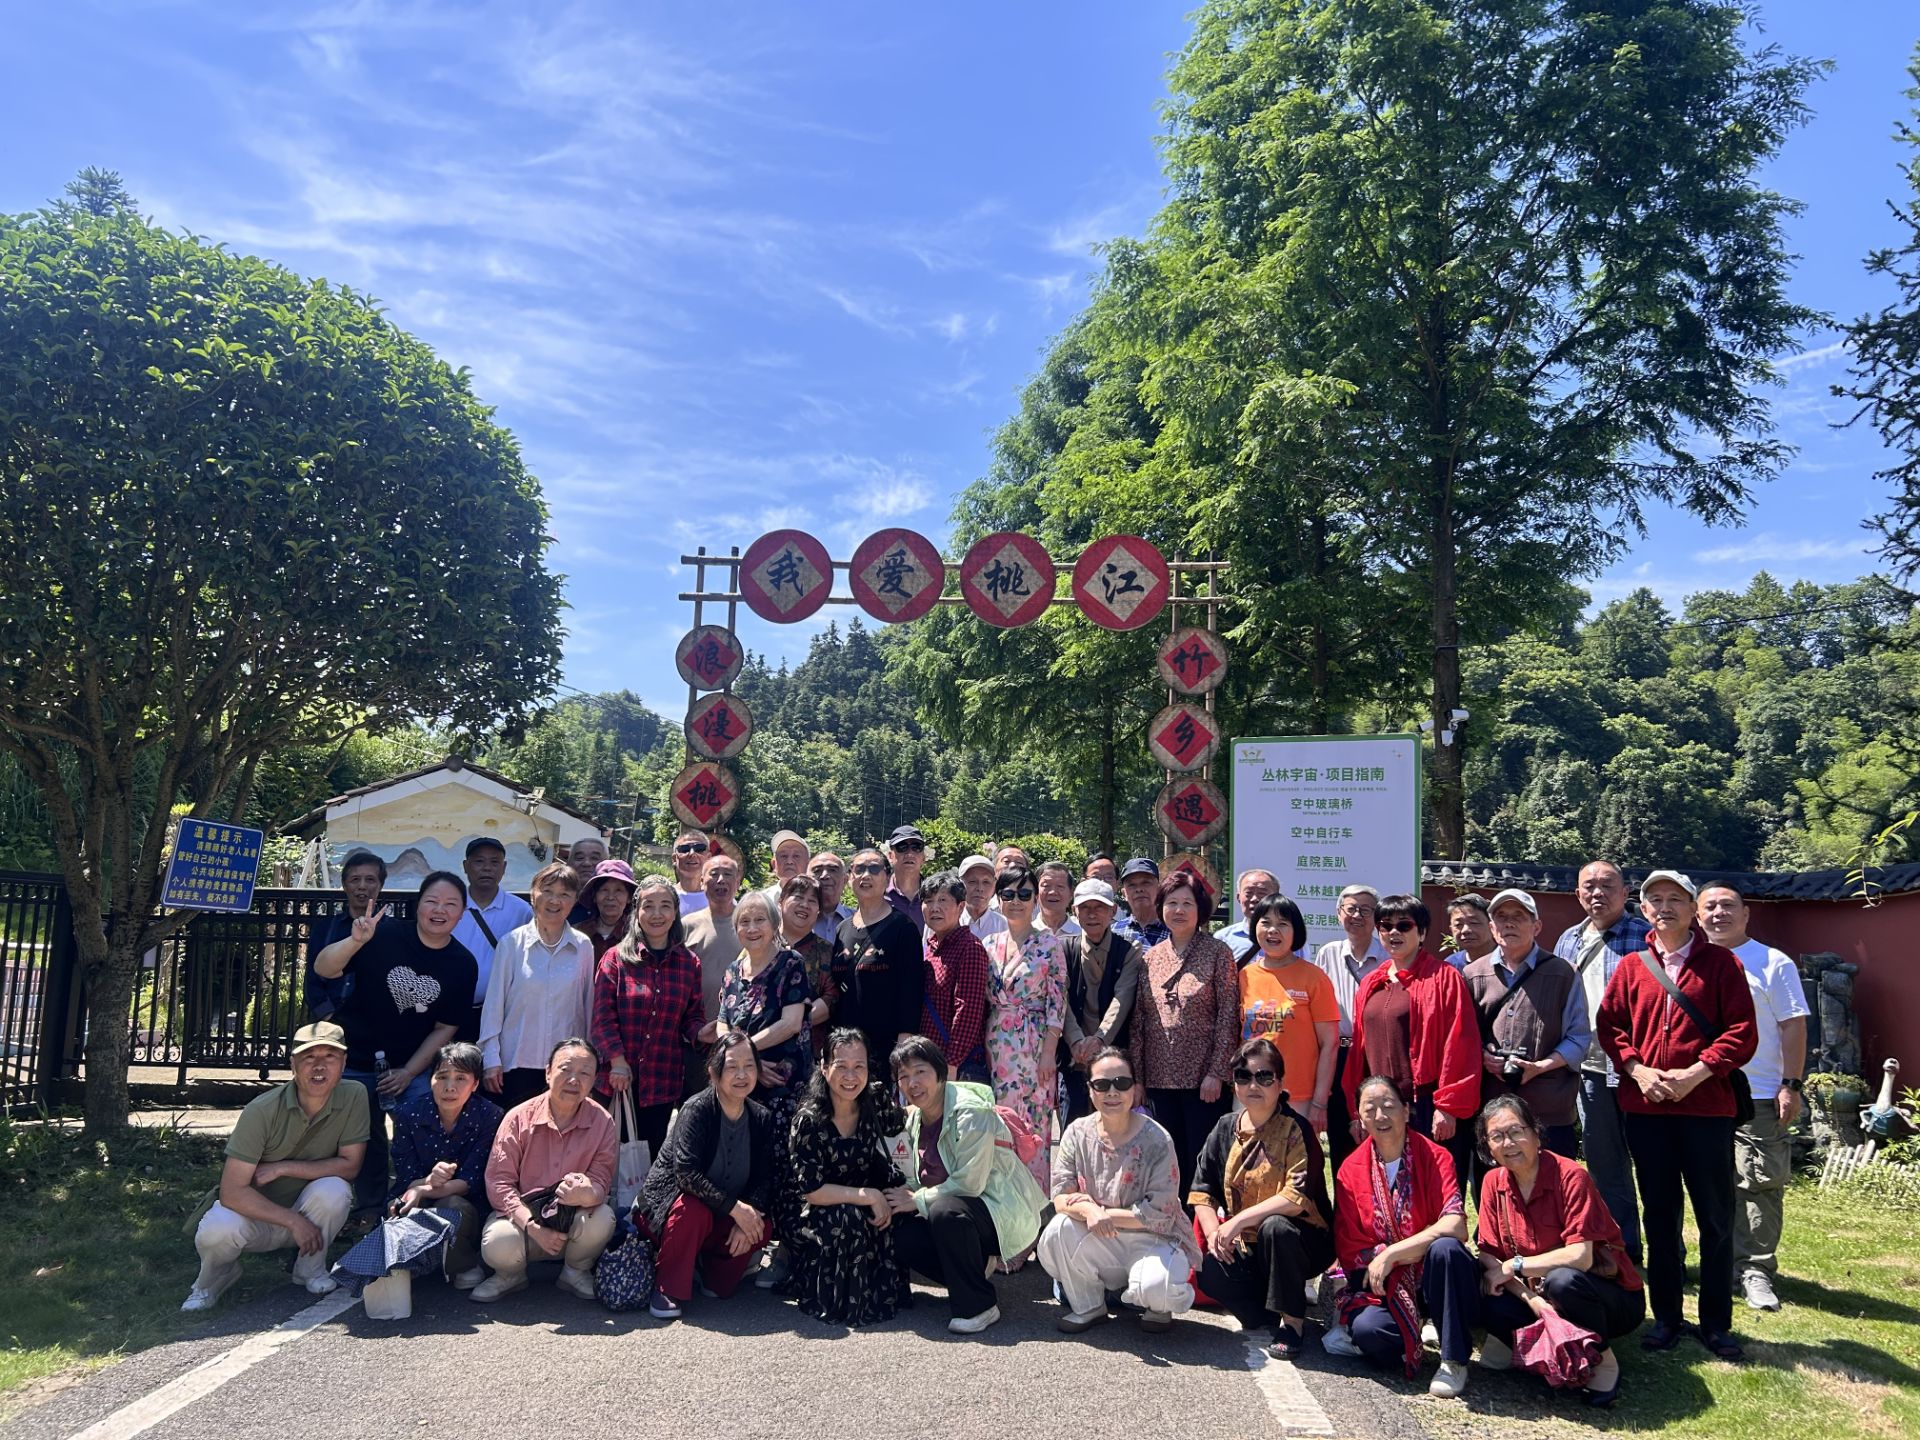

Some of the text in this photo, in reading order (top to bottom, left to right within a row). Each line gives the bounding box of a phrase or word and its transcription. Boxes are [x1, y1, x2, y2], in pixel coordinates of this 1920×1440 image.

[766, 549, 1145, 604] 我爱桃江
[1262, 767, 1385, 782] 丛林宇宙·项目指南
[1290, 798, 1353, 810] 空中玻璃桥
[1290, 826, 1353, 838] 空中自行车
[1297, 855, 1346, 868] 庭院轰趴
[1249, 1020, 1284, 1034] LOVE
